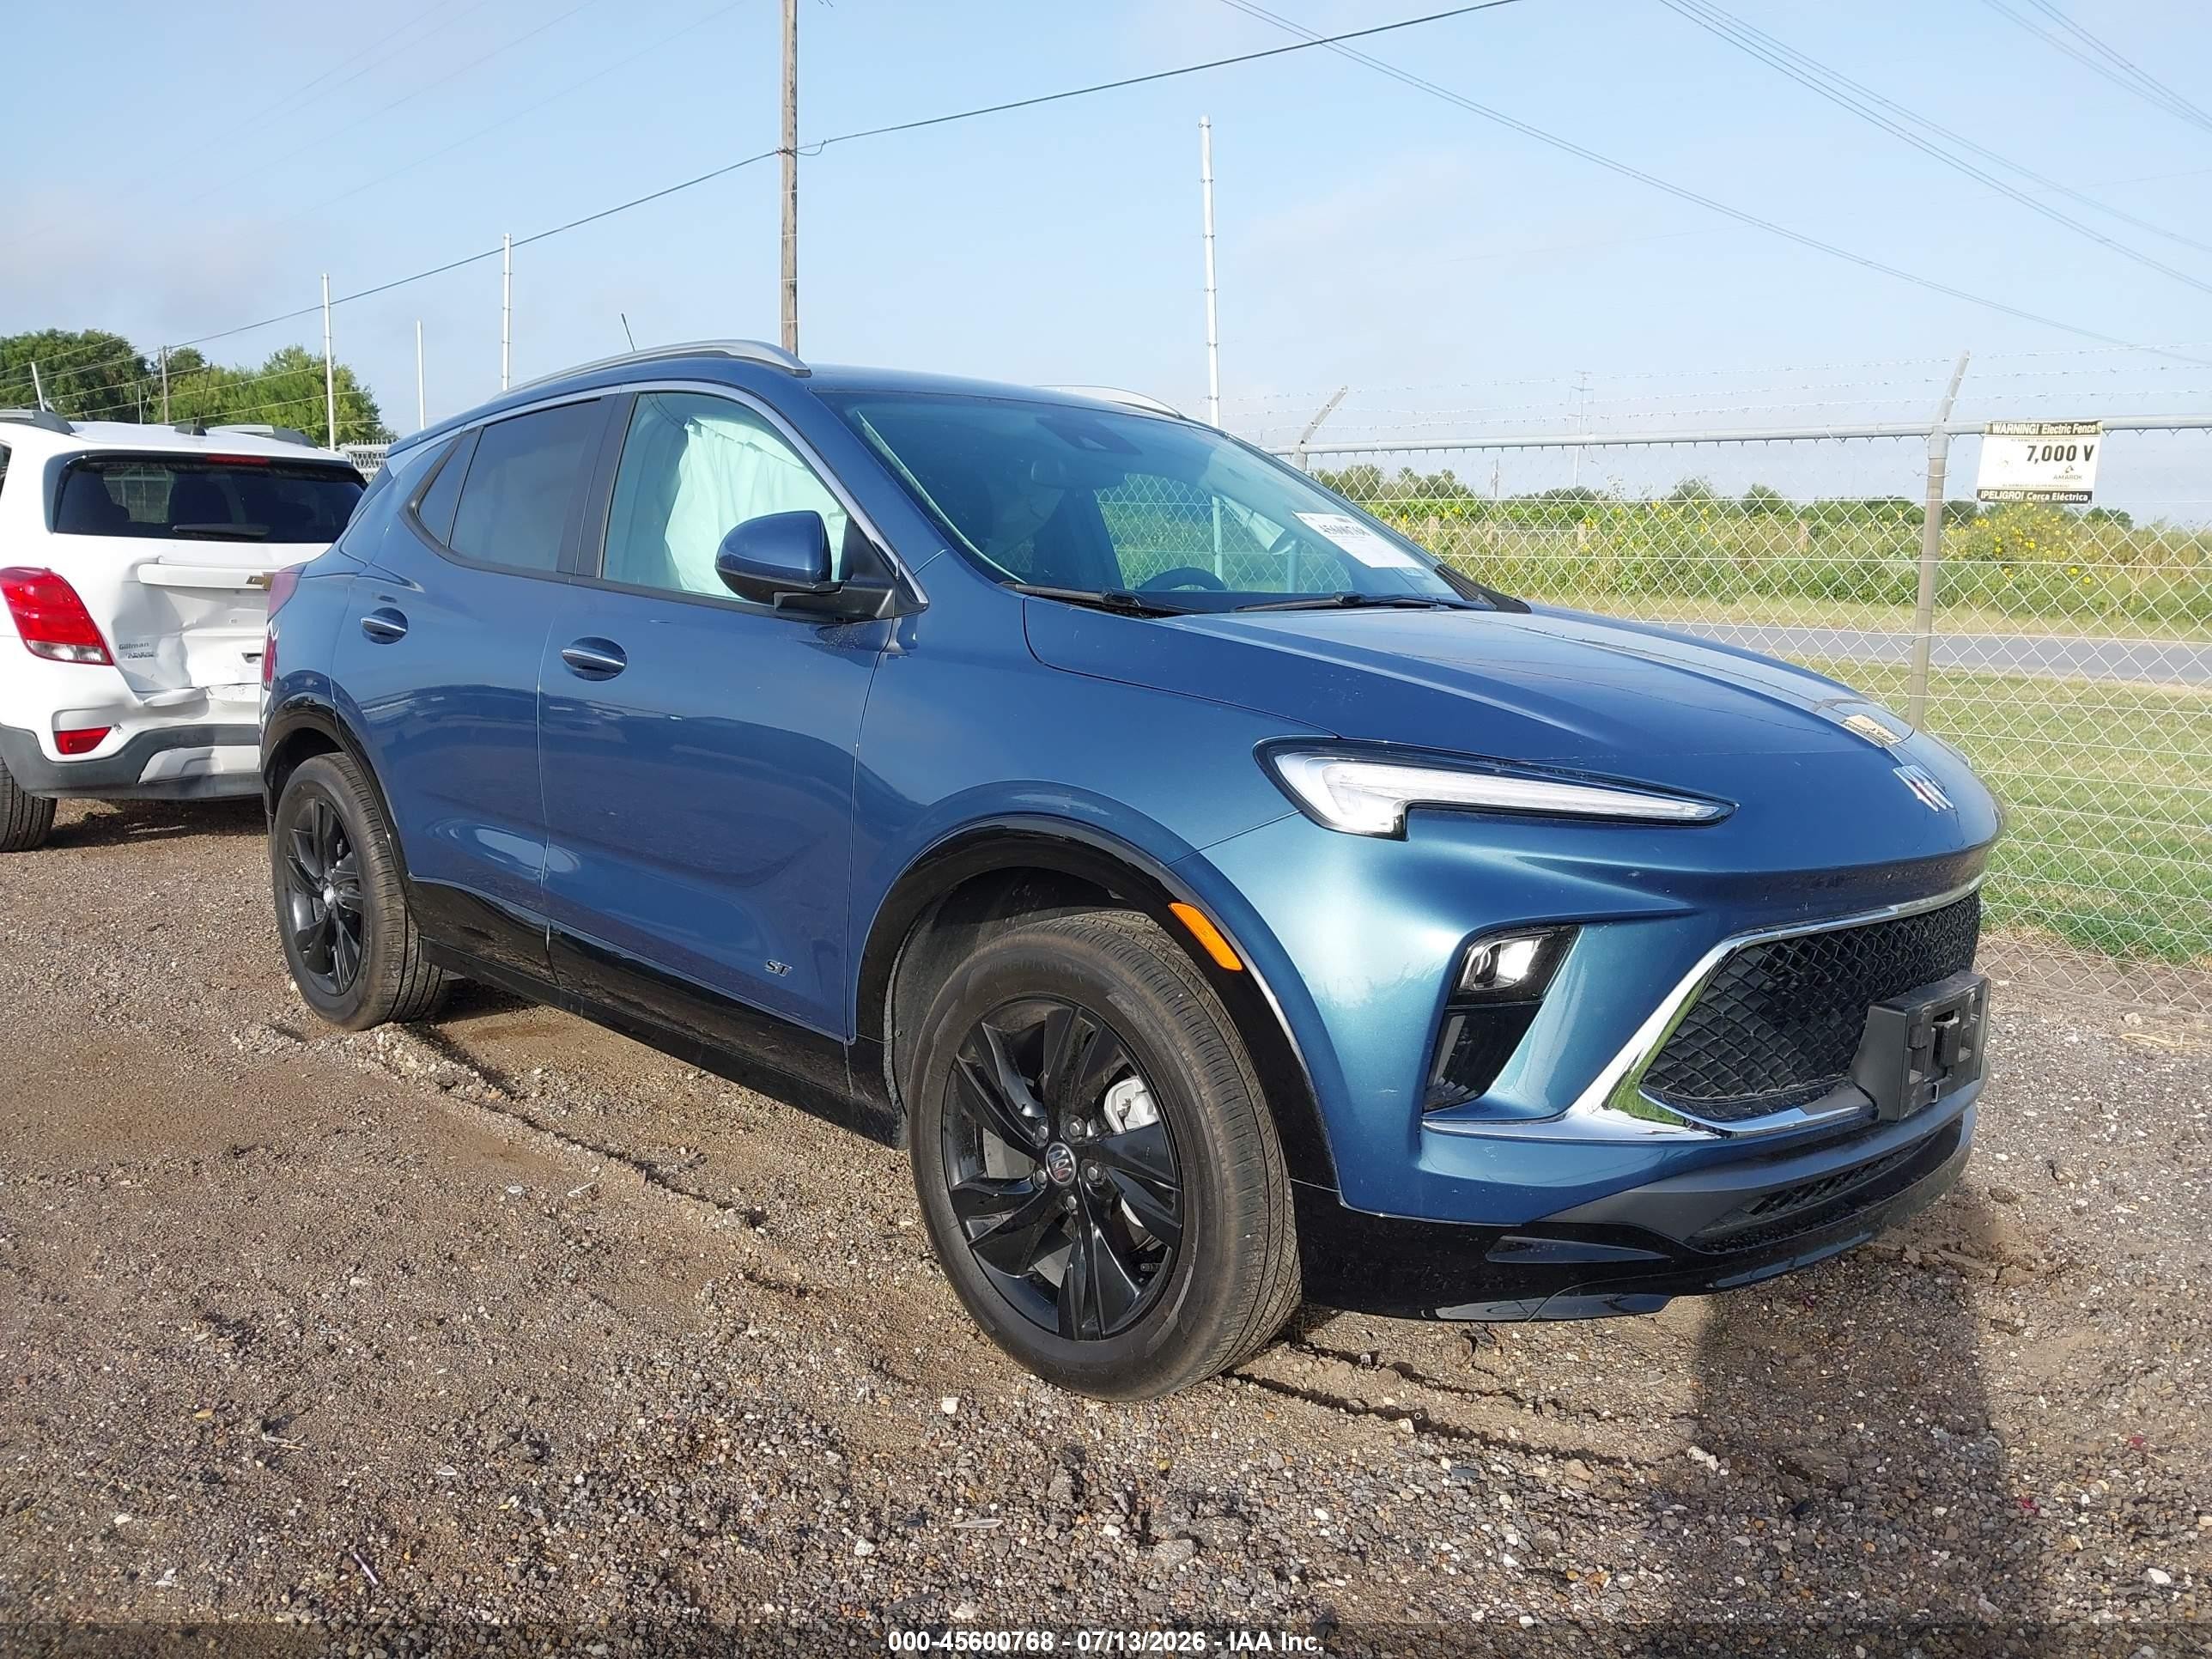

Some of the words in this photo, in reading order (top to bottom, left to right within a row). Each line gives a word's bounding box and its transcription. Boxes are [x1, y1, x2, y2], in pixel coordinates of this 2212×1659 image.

[1992, 422, 2039, 434] WARNING!
[2041, 423, 2072, 434] Electric
[2073, 422, 2096, 434] Fence
[2027, 445, 2077, 465] 7,000
[2084, 445, 2094, 461] V
[2027, 492, 2051, 501] Cerca
[2052, 492, 2088, 501] Eléctrica
[764, 959, 793, 976] ST
